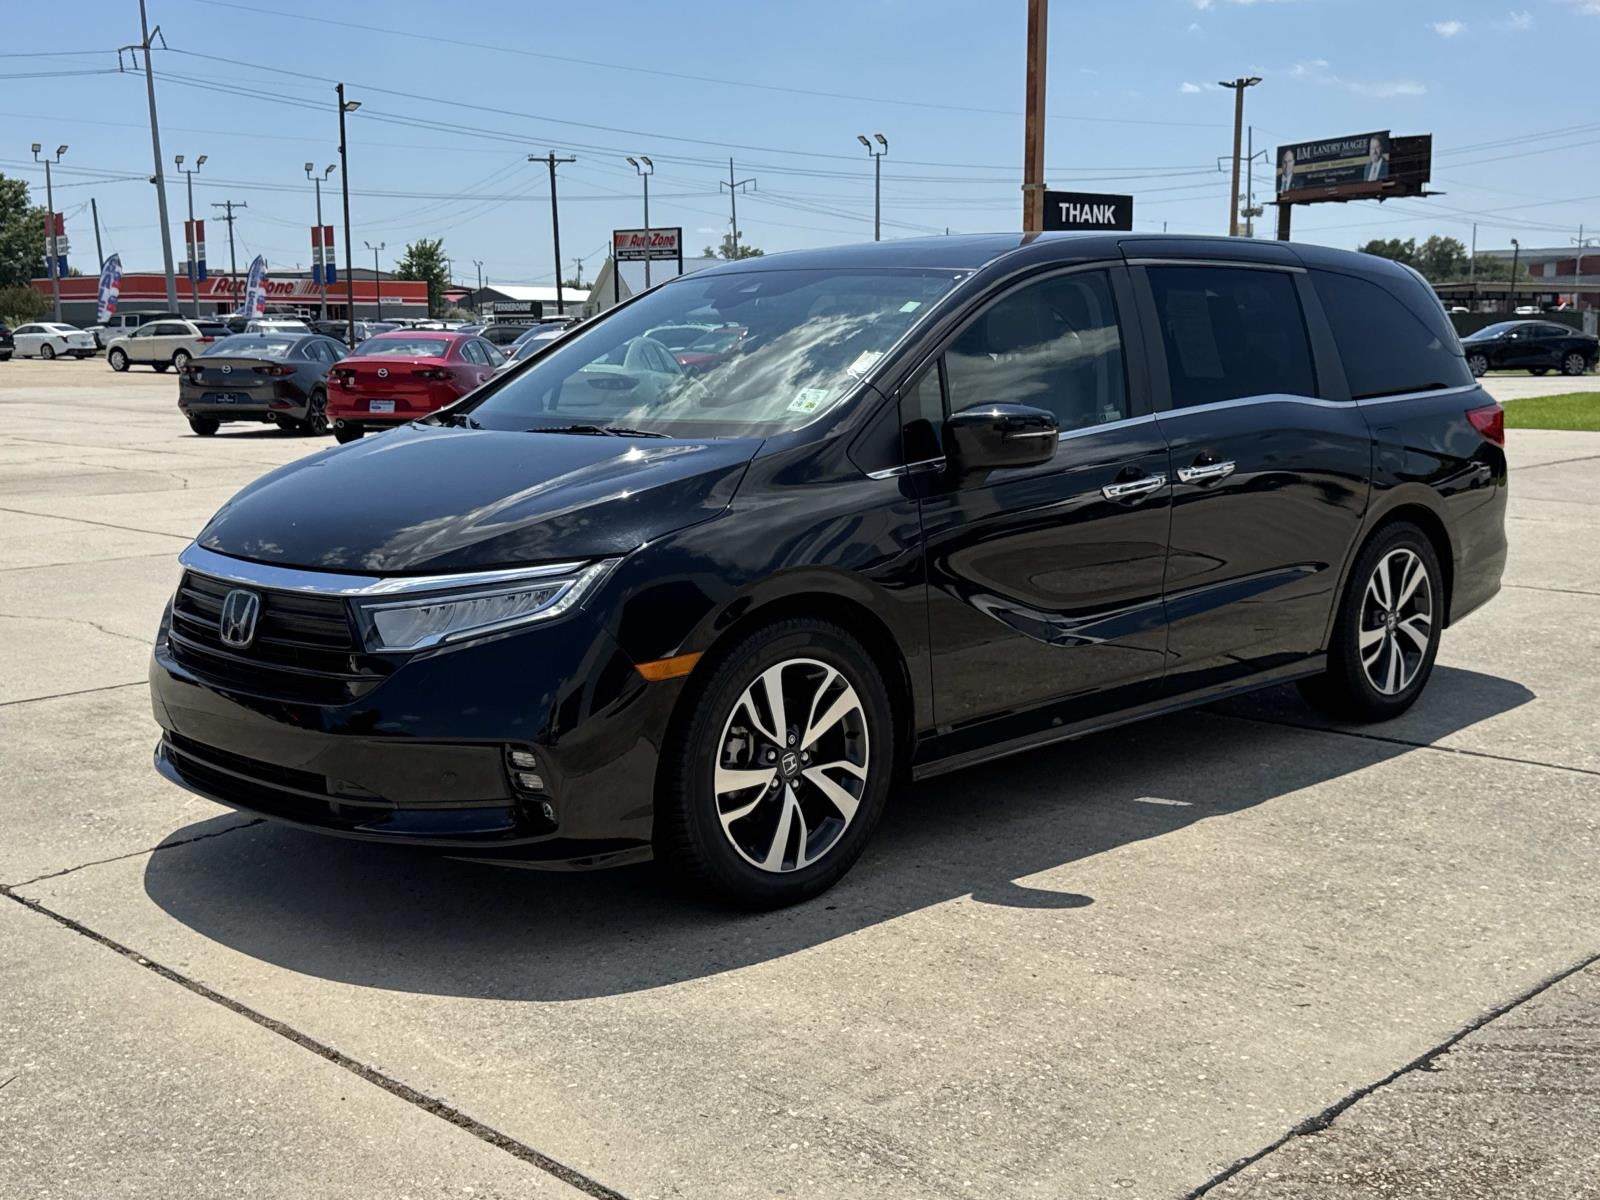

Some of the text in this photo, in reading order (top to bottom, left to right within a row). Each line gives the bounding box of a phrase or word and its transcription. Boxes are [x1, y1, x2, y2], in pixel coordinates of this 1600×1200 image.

[1313, 142, 1342, 155] LANDRY
[1058, 202, 1116, 225] THANK
[213, 278, 295, 294] Autone
